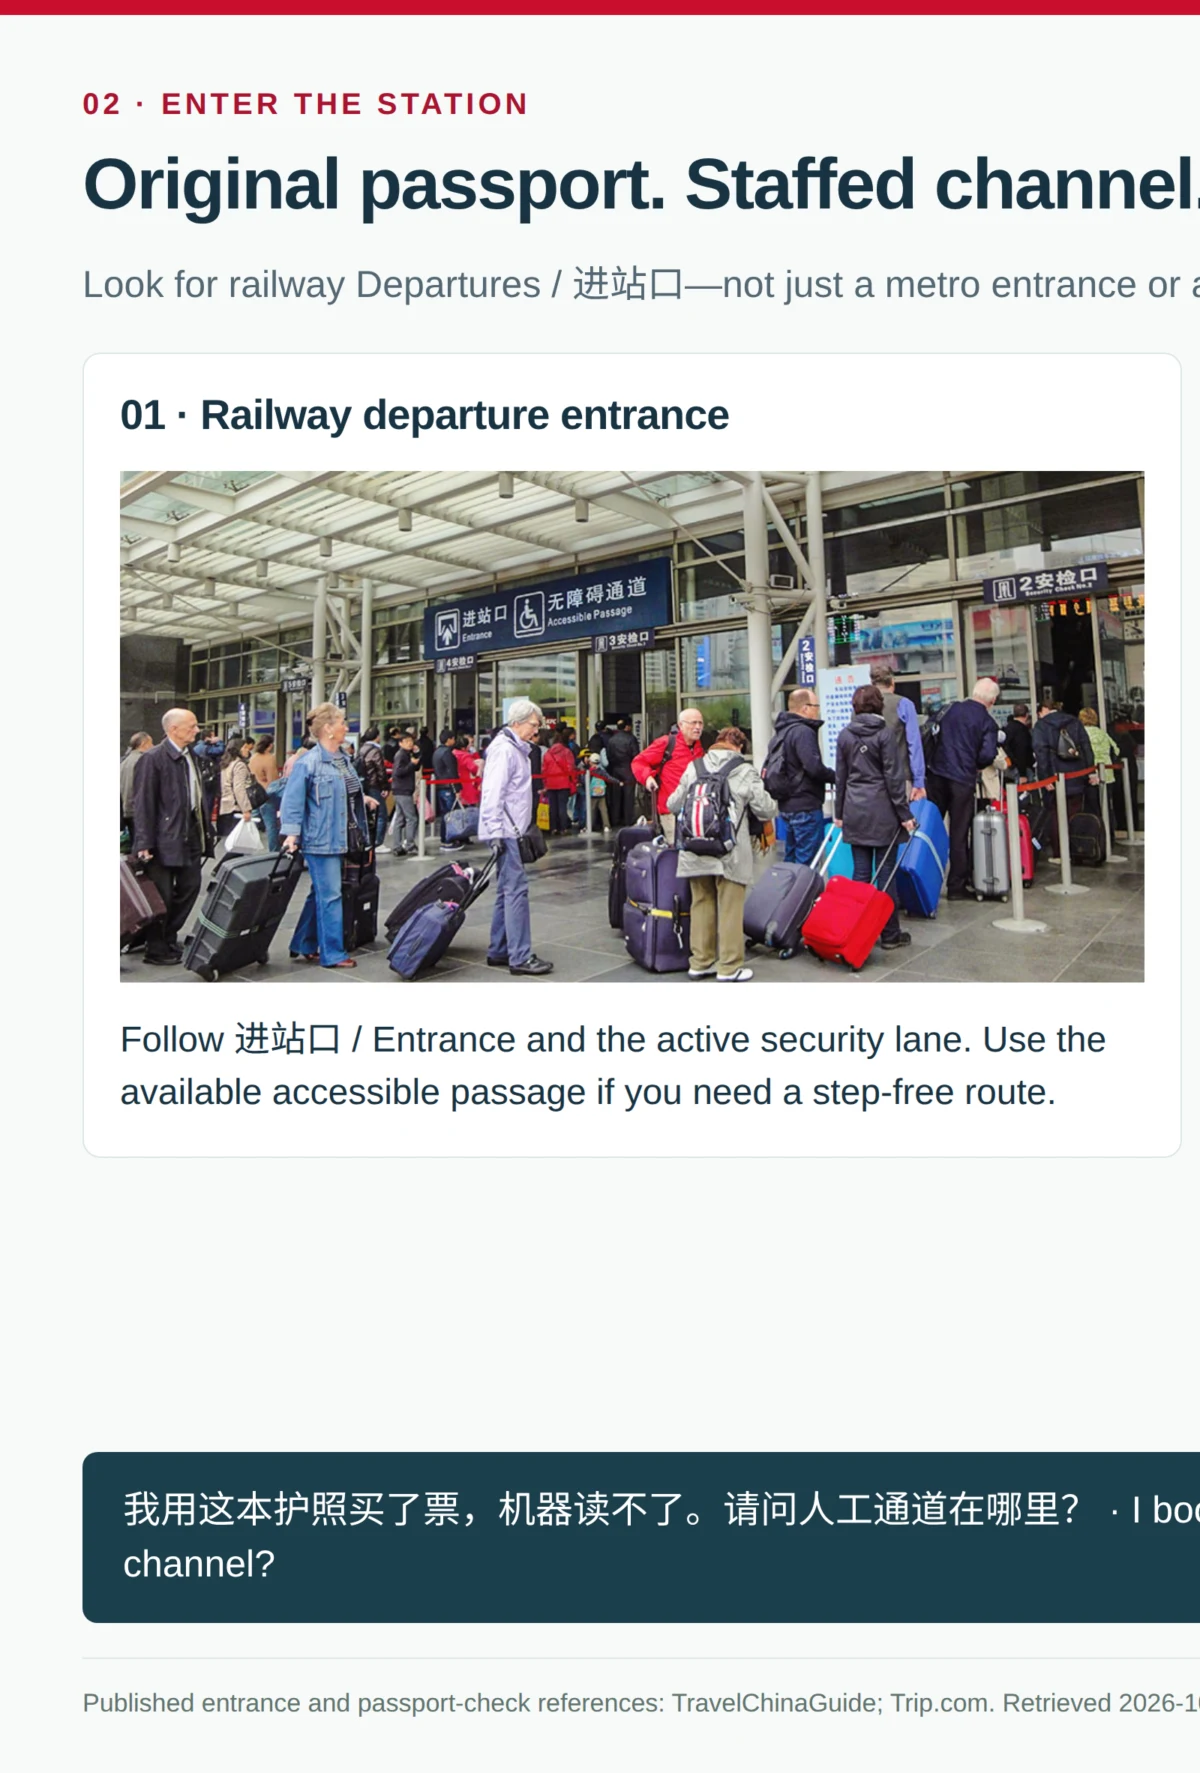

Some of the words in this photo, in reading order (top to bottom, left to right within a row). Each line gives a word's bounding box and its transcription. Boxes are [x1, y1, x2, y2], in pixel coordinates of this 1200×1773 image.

[1019, 567, 1098, 592] 2安检口
[547, 575, 647, 612] 无障碍通道
[462, 604, 508, 628] 进站口
[547, 612, 592, 627] Accessible
[593, 605, 633, 621] Passage
[462, 630, 493, 643] Entrance
